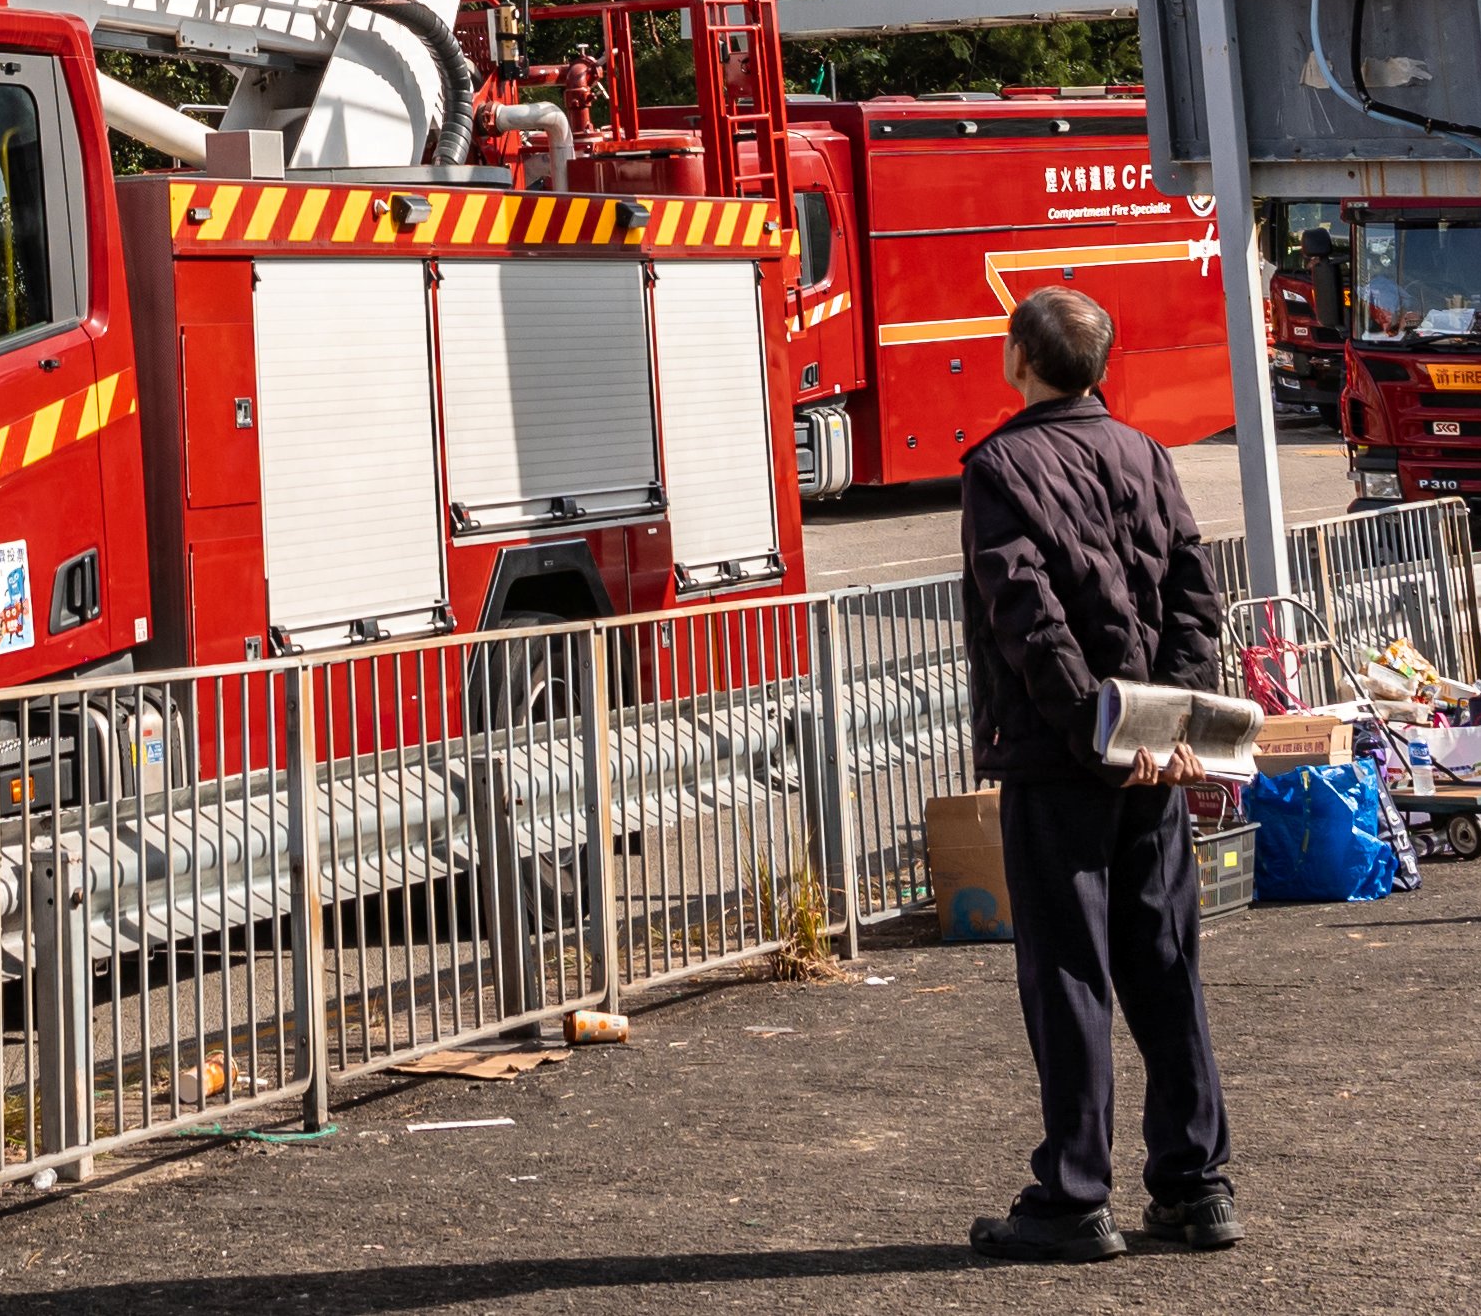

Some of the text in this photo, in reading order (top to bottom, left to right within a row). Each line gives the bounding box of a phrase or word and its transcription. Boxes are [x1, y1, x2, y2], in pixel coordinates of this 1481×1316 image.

[1047, 201, 1171, 221] Compartment Fire Specialist
[1419, 479, 1458, 490] P 310
